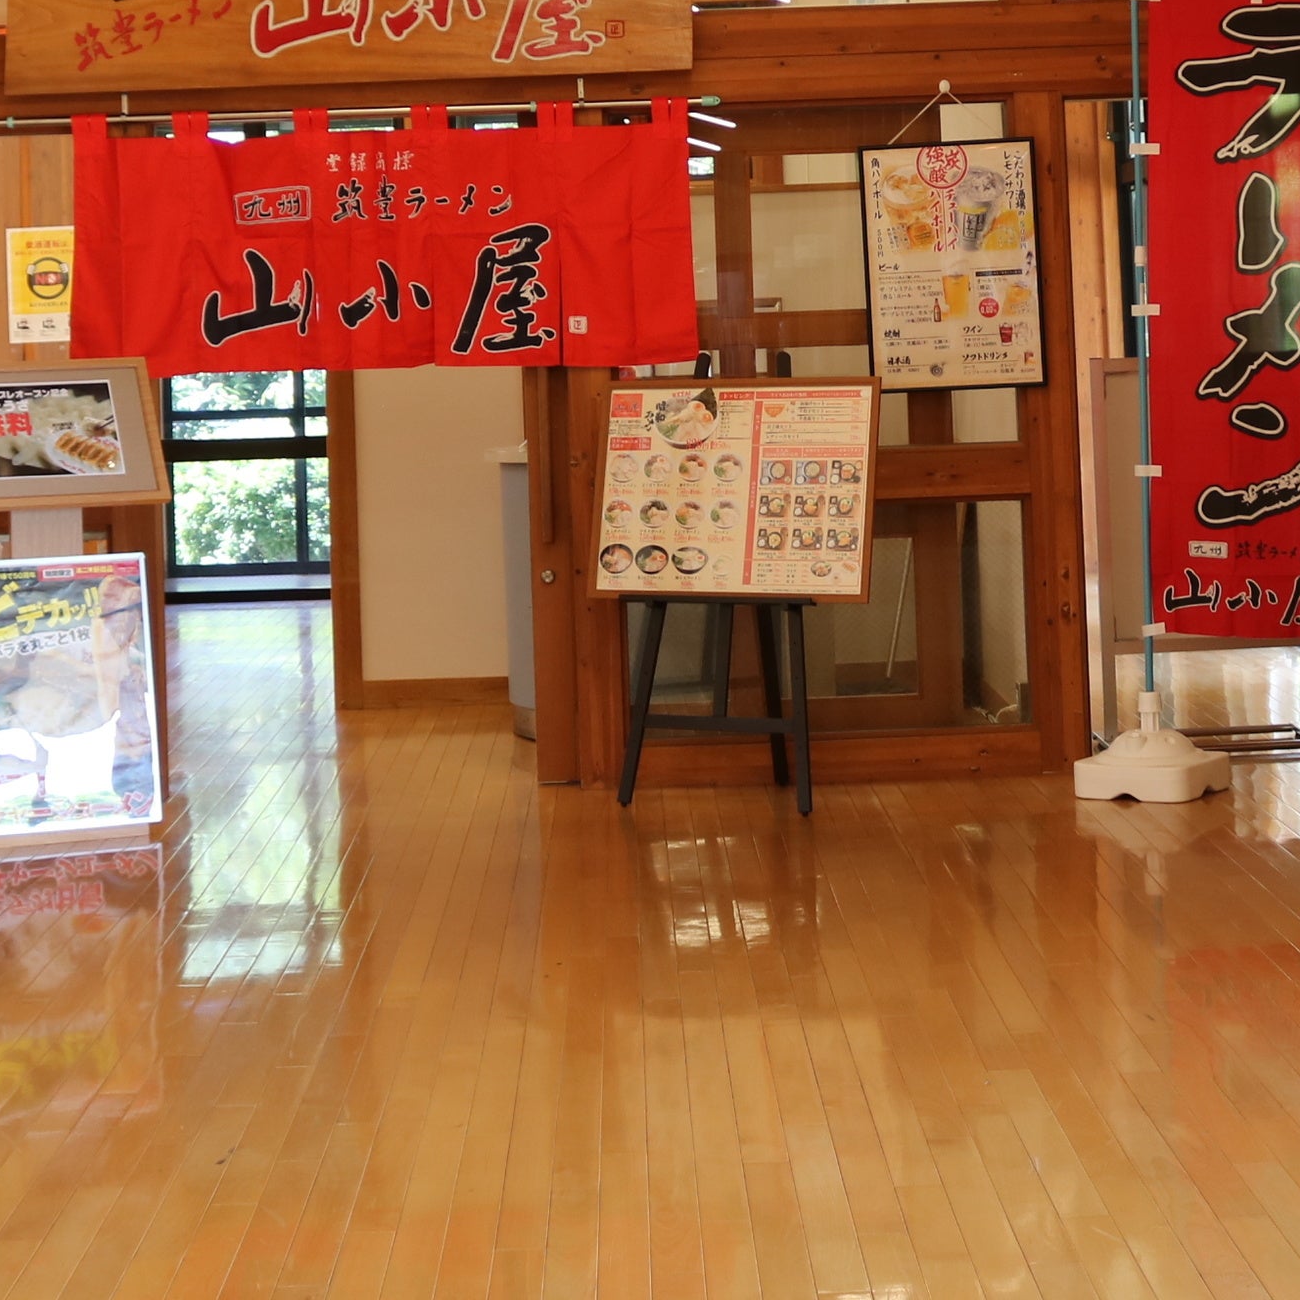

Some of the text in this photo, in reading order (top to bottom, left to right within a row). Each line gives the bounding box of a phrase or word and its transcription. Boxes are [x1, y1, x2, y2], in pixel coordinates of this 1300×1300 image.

[243, 190, 302, 219] 九州
[331, 174, 512, 223] 筑豊ラーメン
[871, 157, 883, 219] 角ハイボール
[1003, 150, 1014, 210] レモンサワー
[930, 190, 944, 252] ハイボール
[202, 223, 557, 355] 山小屋
[878, 263, 900, 272] ビール
[963, 324, 983, 334] ワイン
[887, 356, 911, 366] 日本酒
